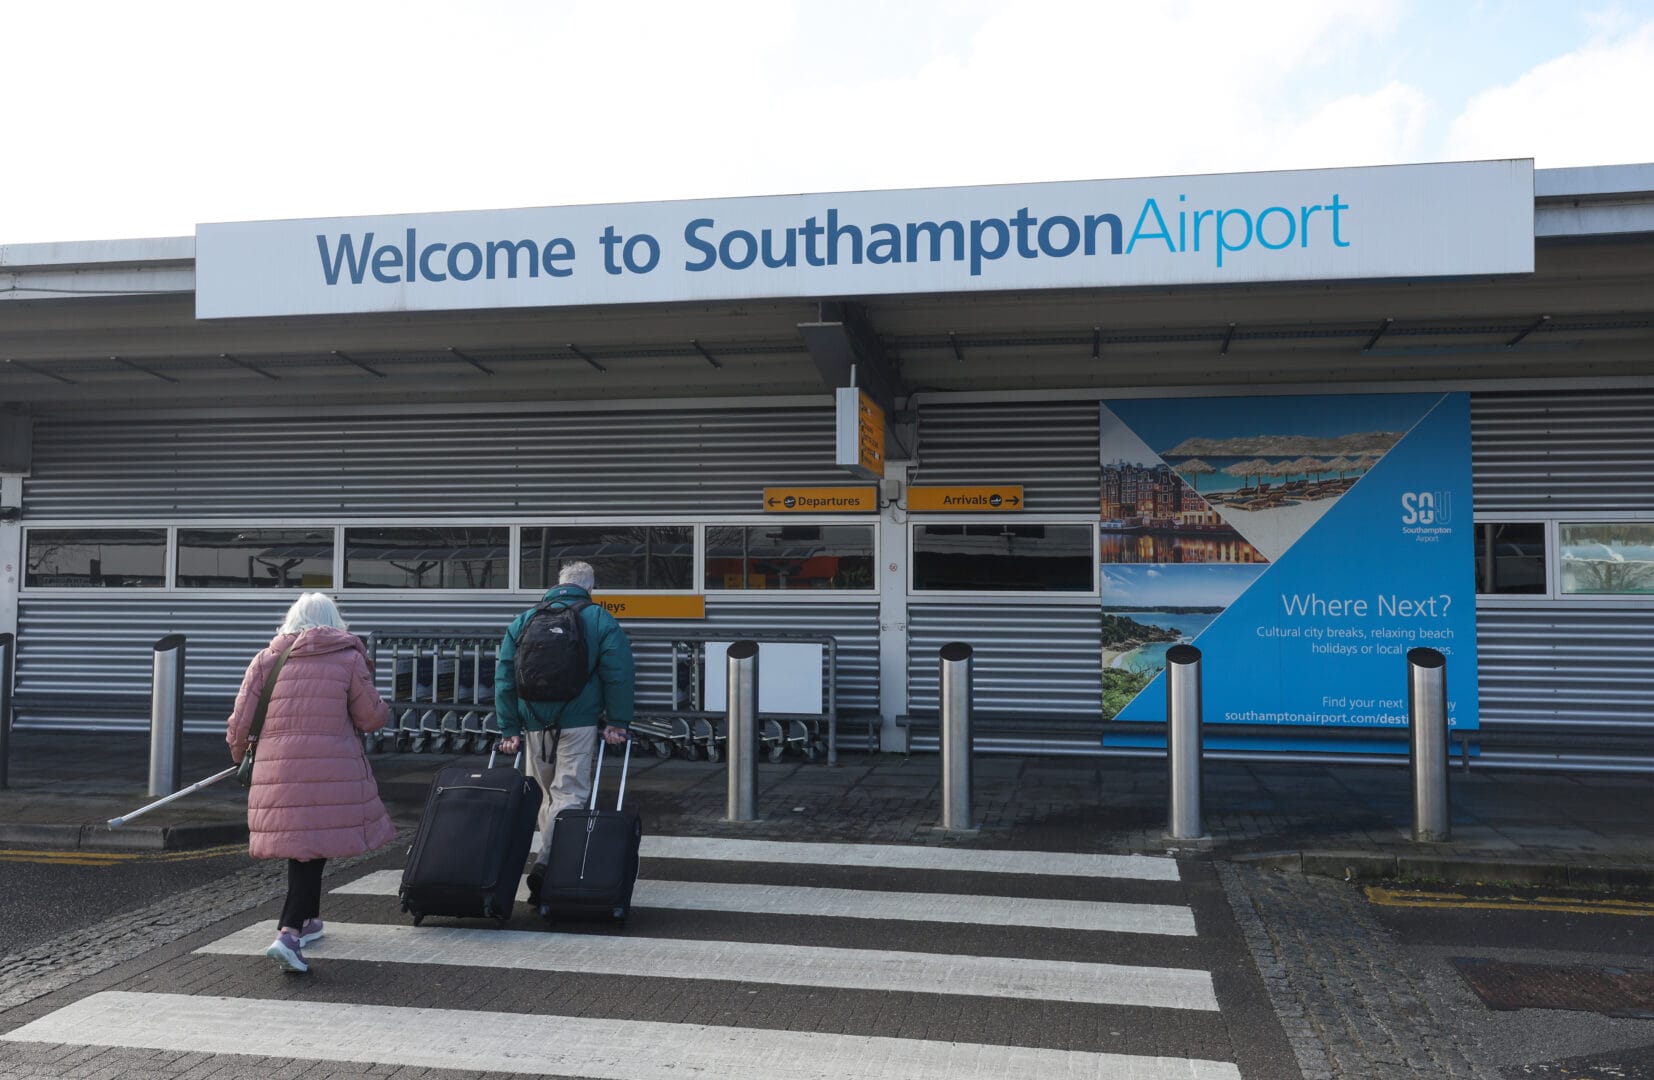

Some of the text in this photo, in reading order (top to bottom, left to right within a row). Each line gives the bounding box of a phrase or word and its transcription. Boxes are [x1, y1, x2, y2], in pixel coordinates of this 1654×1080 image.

[316, 194, 1350, 286] Welcome to SouthamptonAirport
[798, 496, 861, 507] Departures
[943, 495, 988, 505] Arrivals
[1401, 491, 1452, 525] SOU
[1402, 527, 1452, 535] Southampton
[1416, 535, 1439, 543] Airport
[600, 600, 626, 613] lleys
[1281, 593, 1452, 617] Where Next?
[1256, 626, 1454, 640] Cultural city breaks, relaxing beach
[1312, 643, 1357, 656] holidays
[1361, 645, 1373, 654] or
[1376, 644, 1402, 654] local
[1322, 696, 1403, 710] Find your next
